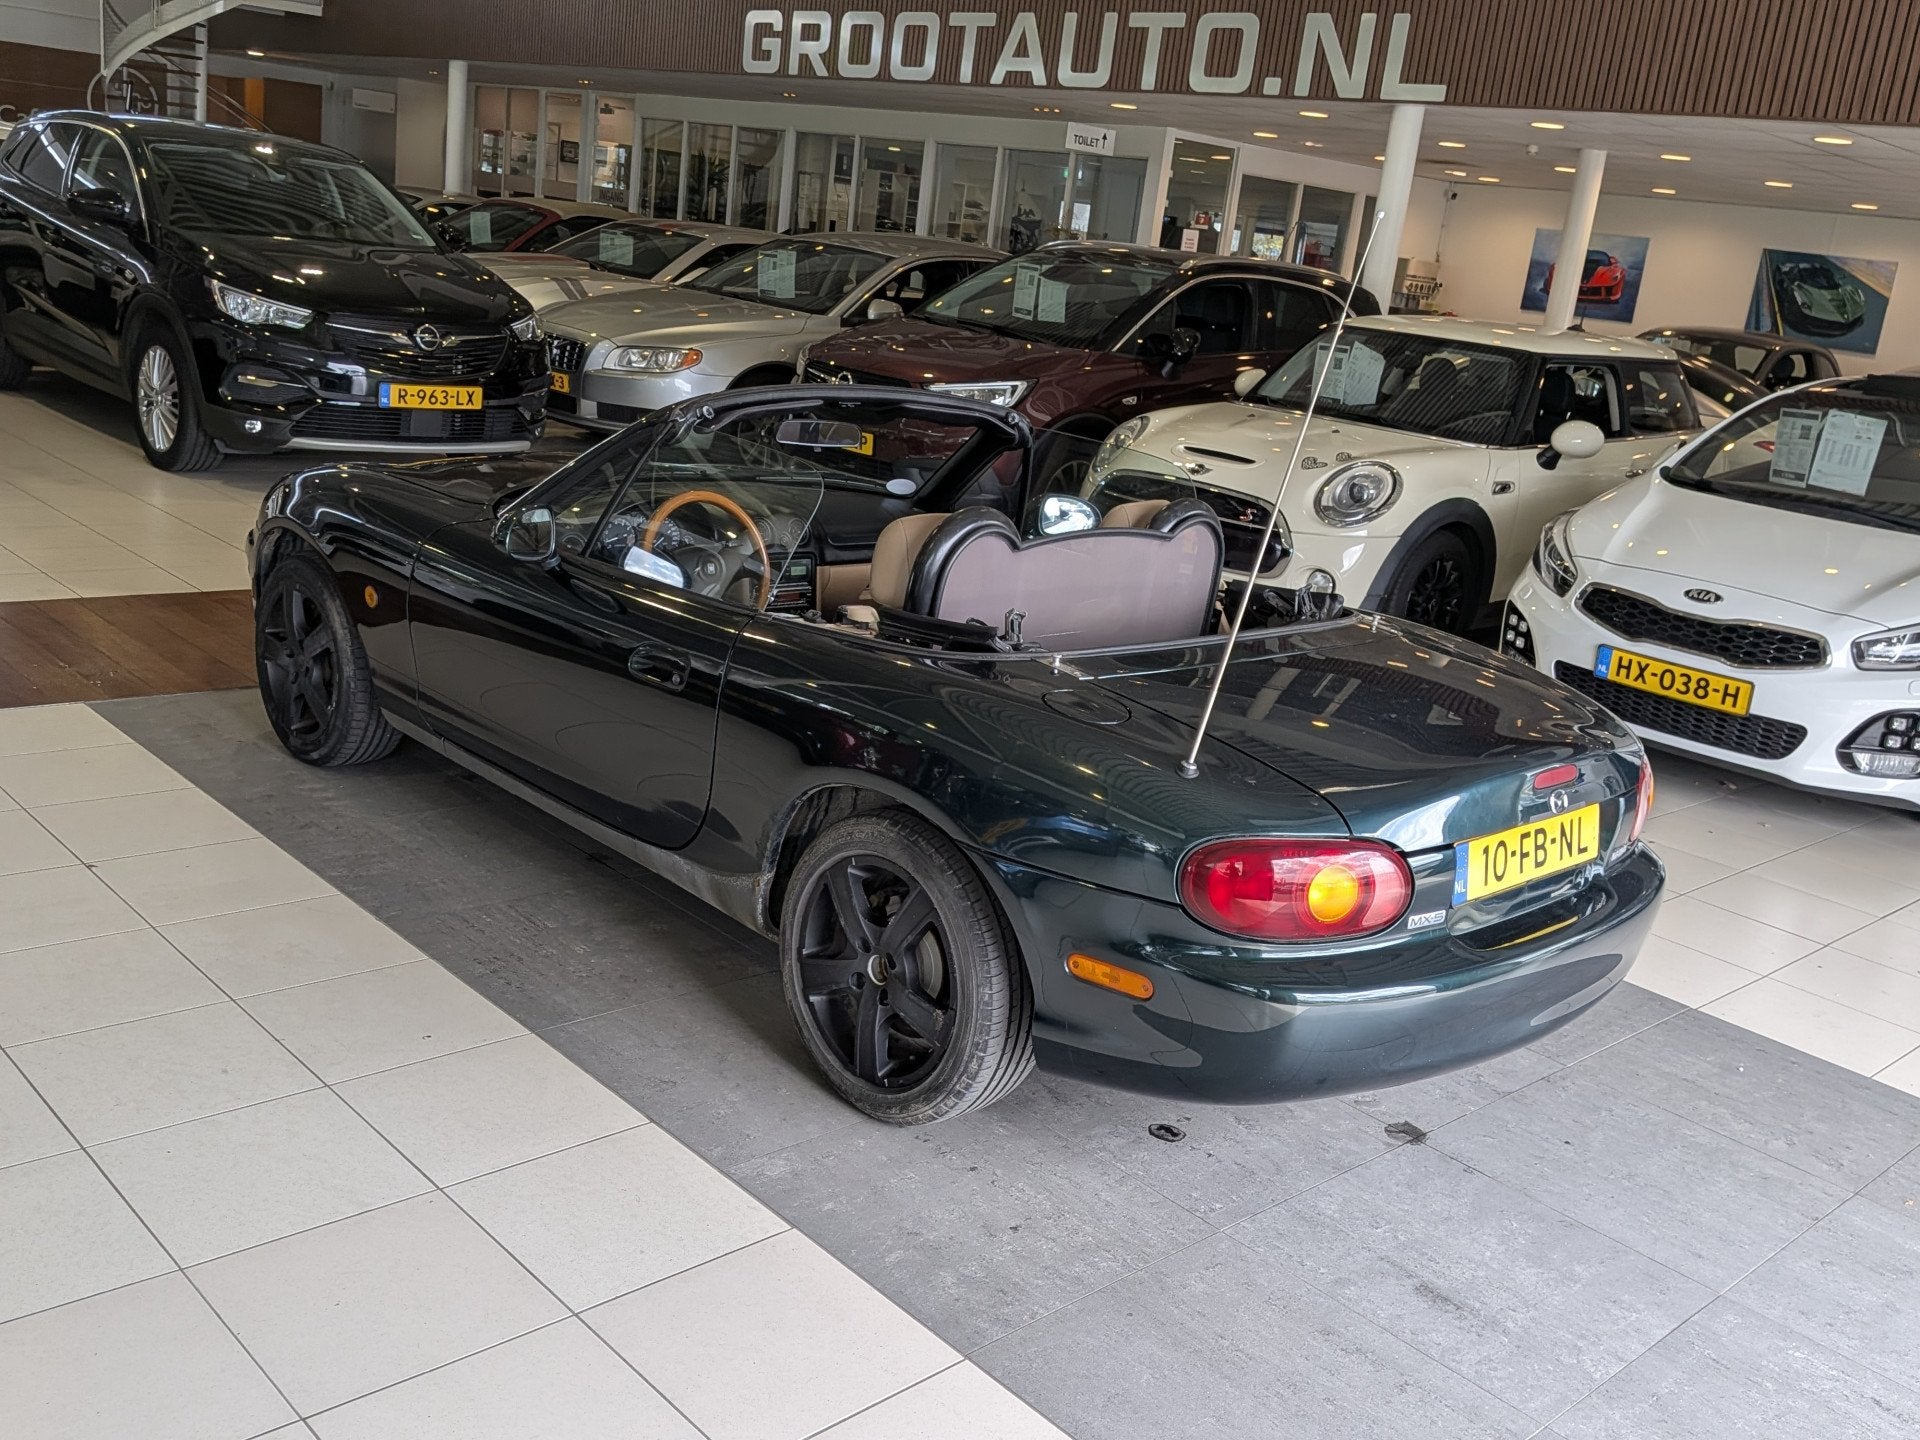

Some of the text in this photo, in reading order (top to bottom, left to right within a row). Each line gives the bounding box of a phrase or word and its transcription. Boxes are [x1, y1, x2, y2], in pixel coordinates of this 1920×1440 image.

[742, 9, 1448, 102] GROOTAUTO.NL
[1073, 133, 1100, 148] TOILET
[398, 387, 475, 406] R-963-LX
[1688, 589, 1716, 602] KIA
[1615, 656, 1741, 708] HX-038-H
[1454, 816, 1589, 894] NL 10-FB-NL
[1409, 911, 1446, 929] MX-5
